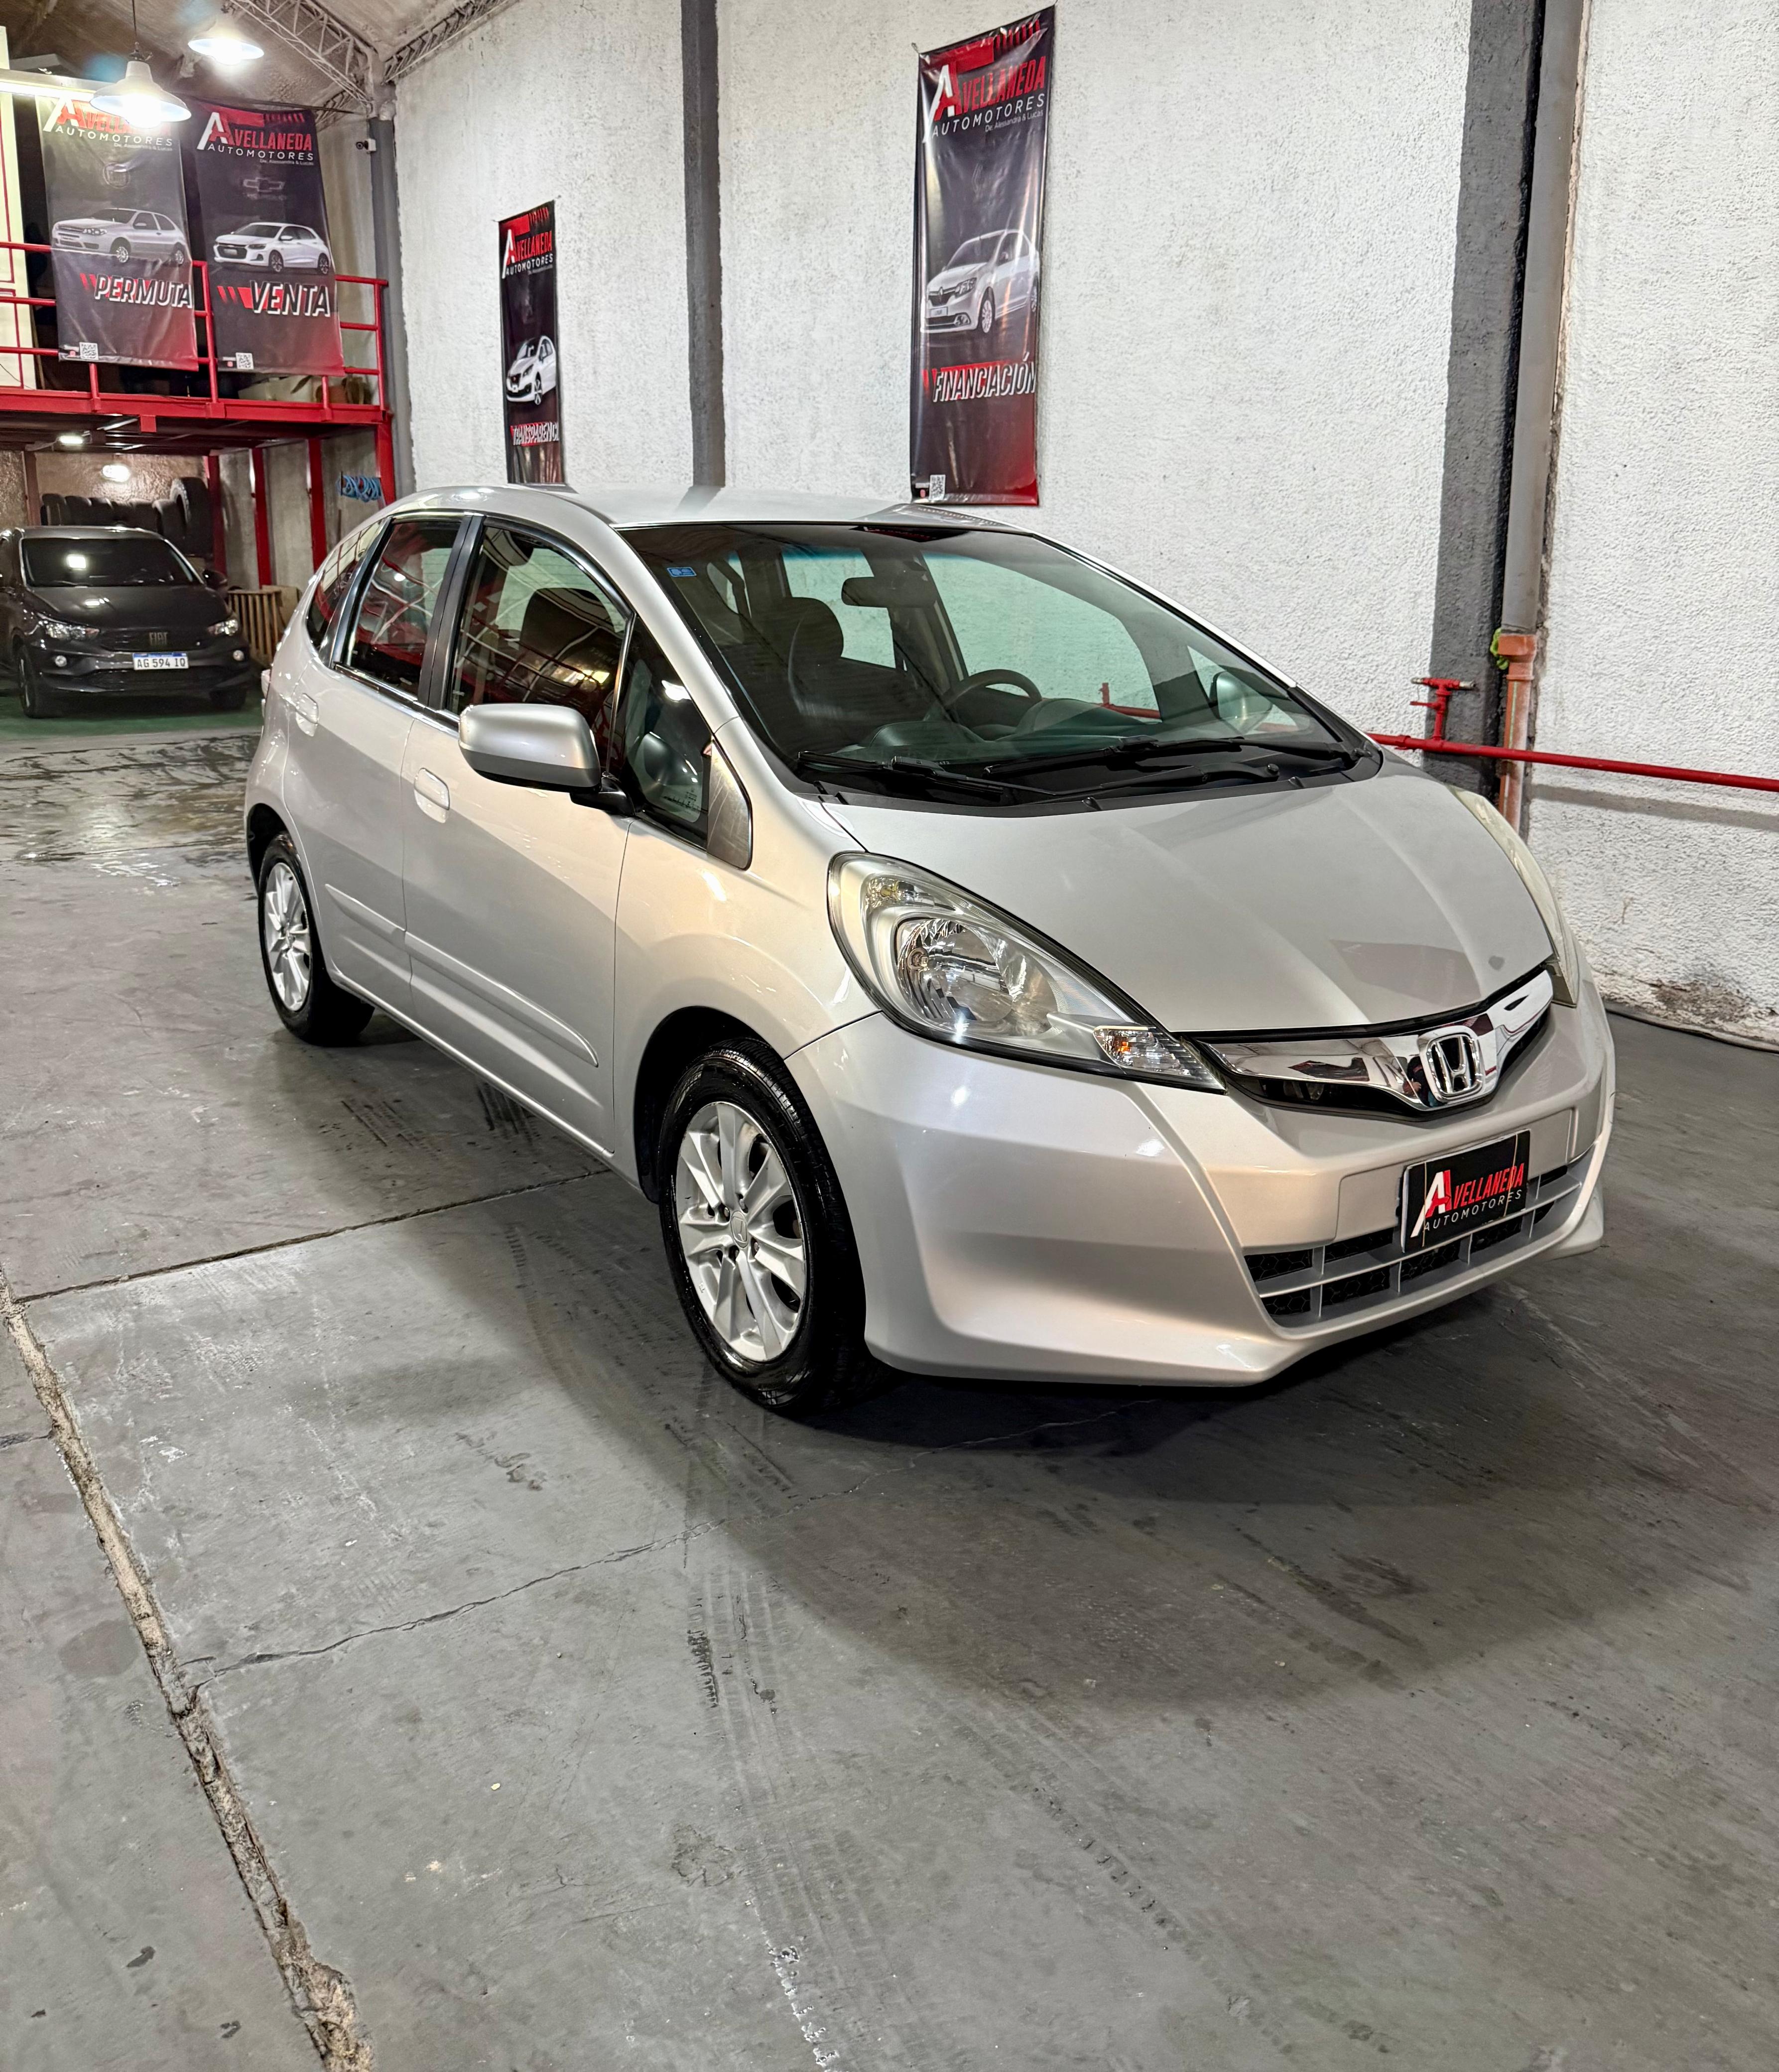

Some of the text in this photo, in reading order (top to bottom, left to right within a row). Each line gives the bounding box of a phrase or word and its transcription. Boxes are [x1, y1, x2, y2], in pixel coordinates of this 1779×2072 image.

[923, 56, 1046, 143] AVELLANEDA
[932, 93, 1045, 138] AUTOMOTORES
[55, 126, 173, 146] AUTOMOTORES
[197, 112, 312, 151] AVELLANEDA
[207, 143, 314, 161] AUTOMOTORES
[502, 229, 552, 279] AVELLANEDA
[506, 253, 553, 276] AUTOMOTORES
[94, 273, 193, 309] PERMUTA
[250, 279, 331, 317] VENTA
[932, 351, 1037, 402] FINANCIACIÓN
[149, 632, 168, 646] FIAT
[137, 658, 149, 668] AG
[152, 658, 170, 668] 594
[1410, 1163, 1525, 1238] AVELLANEDA
[1423, 1189, 1523, 1231] AUTOMOTORES
